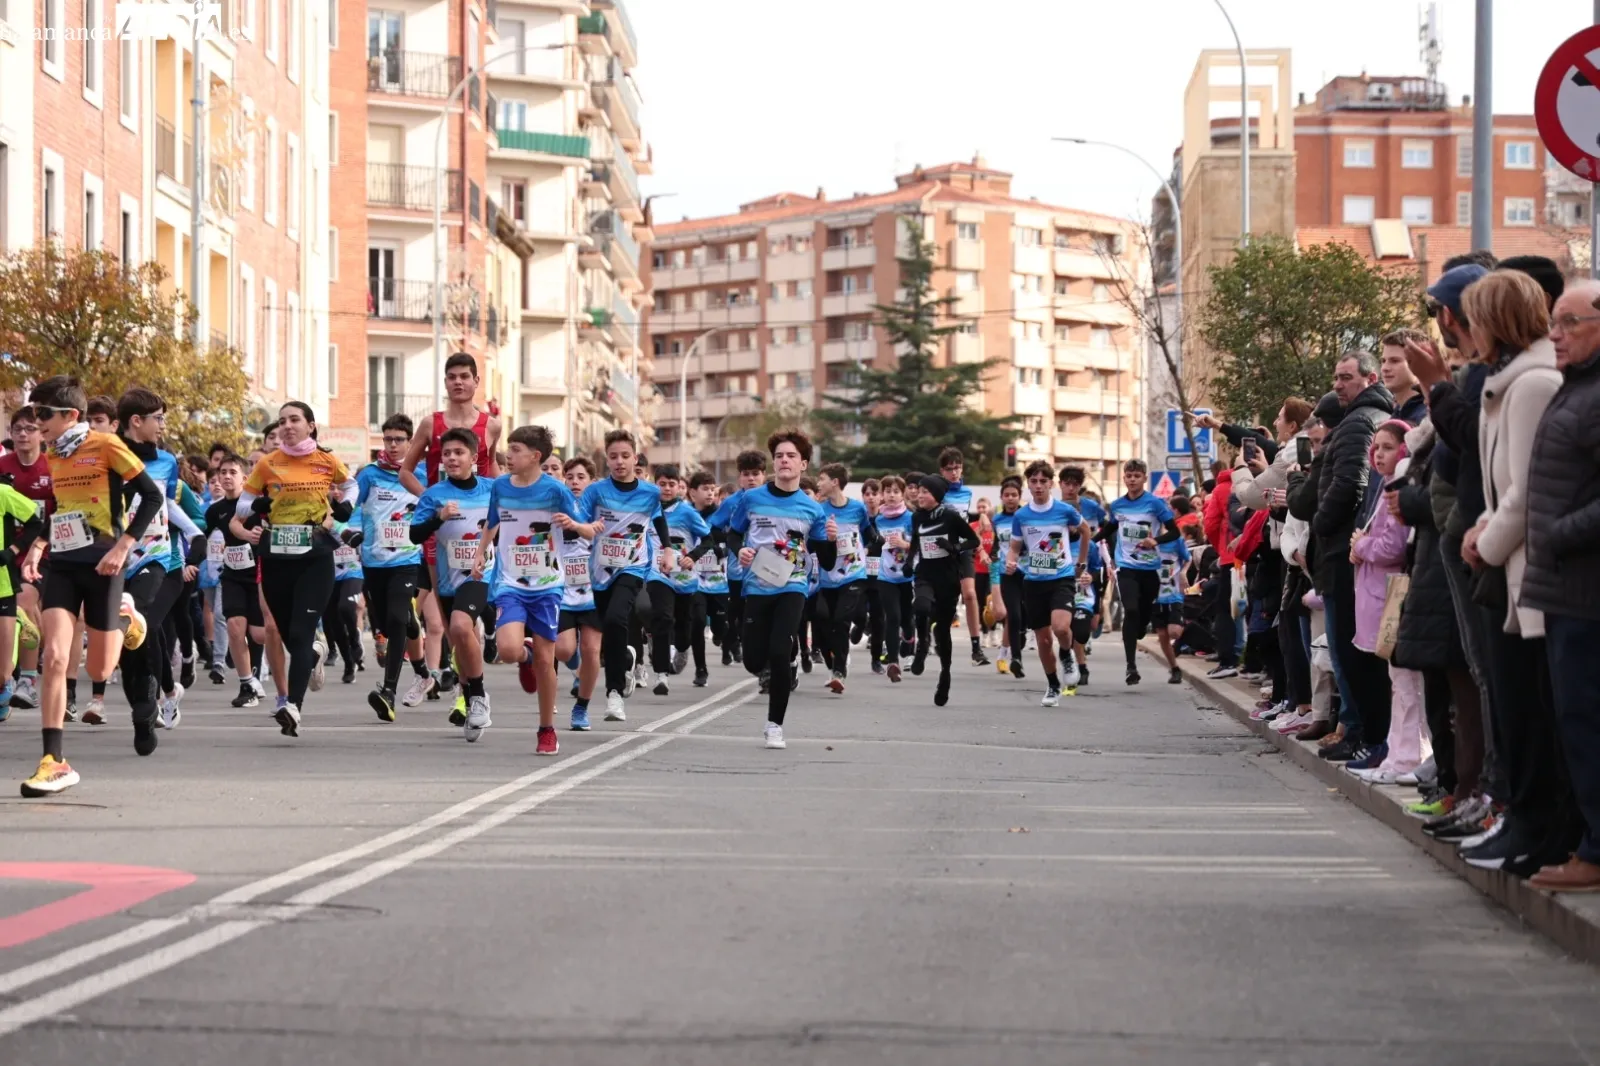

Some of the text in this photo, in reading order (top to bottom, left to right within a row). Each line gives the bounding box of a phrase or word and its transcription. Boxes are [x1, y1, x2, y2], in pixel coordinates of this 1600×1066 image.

[278, 532, 301, 545] 6180
[384, 527, 404, 539] 6142
[226, 552, 245, 562] 6122
[454, 547, 477, 560] 6152
[602, 544, 626, 558] 6304
[514, 553, 539, 567] 6214
[1031, 557, 1050, 568] 6230
[565, 563, 587, 576] 6163
